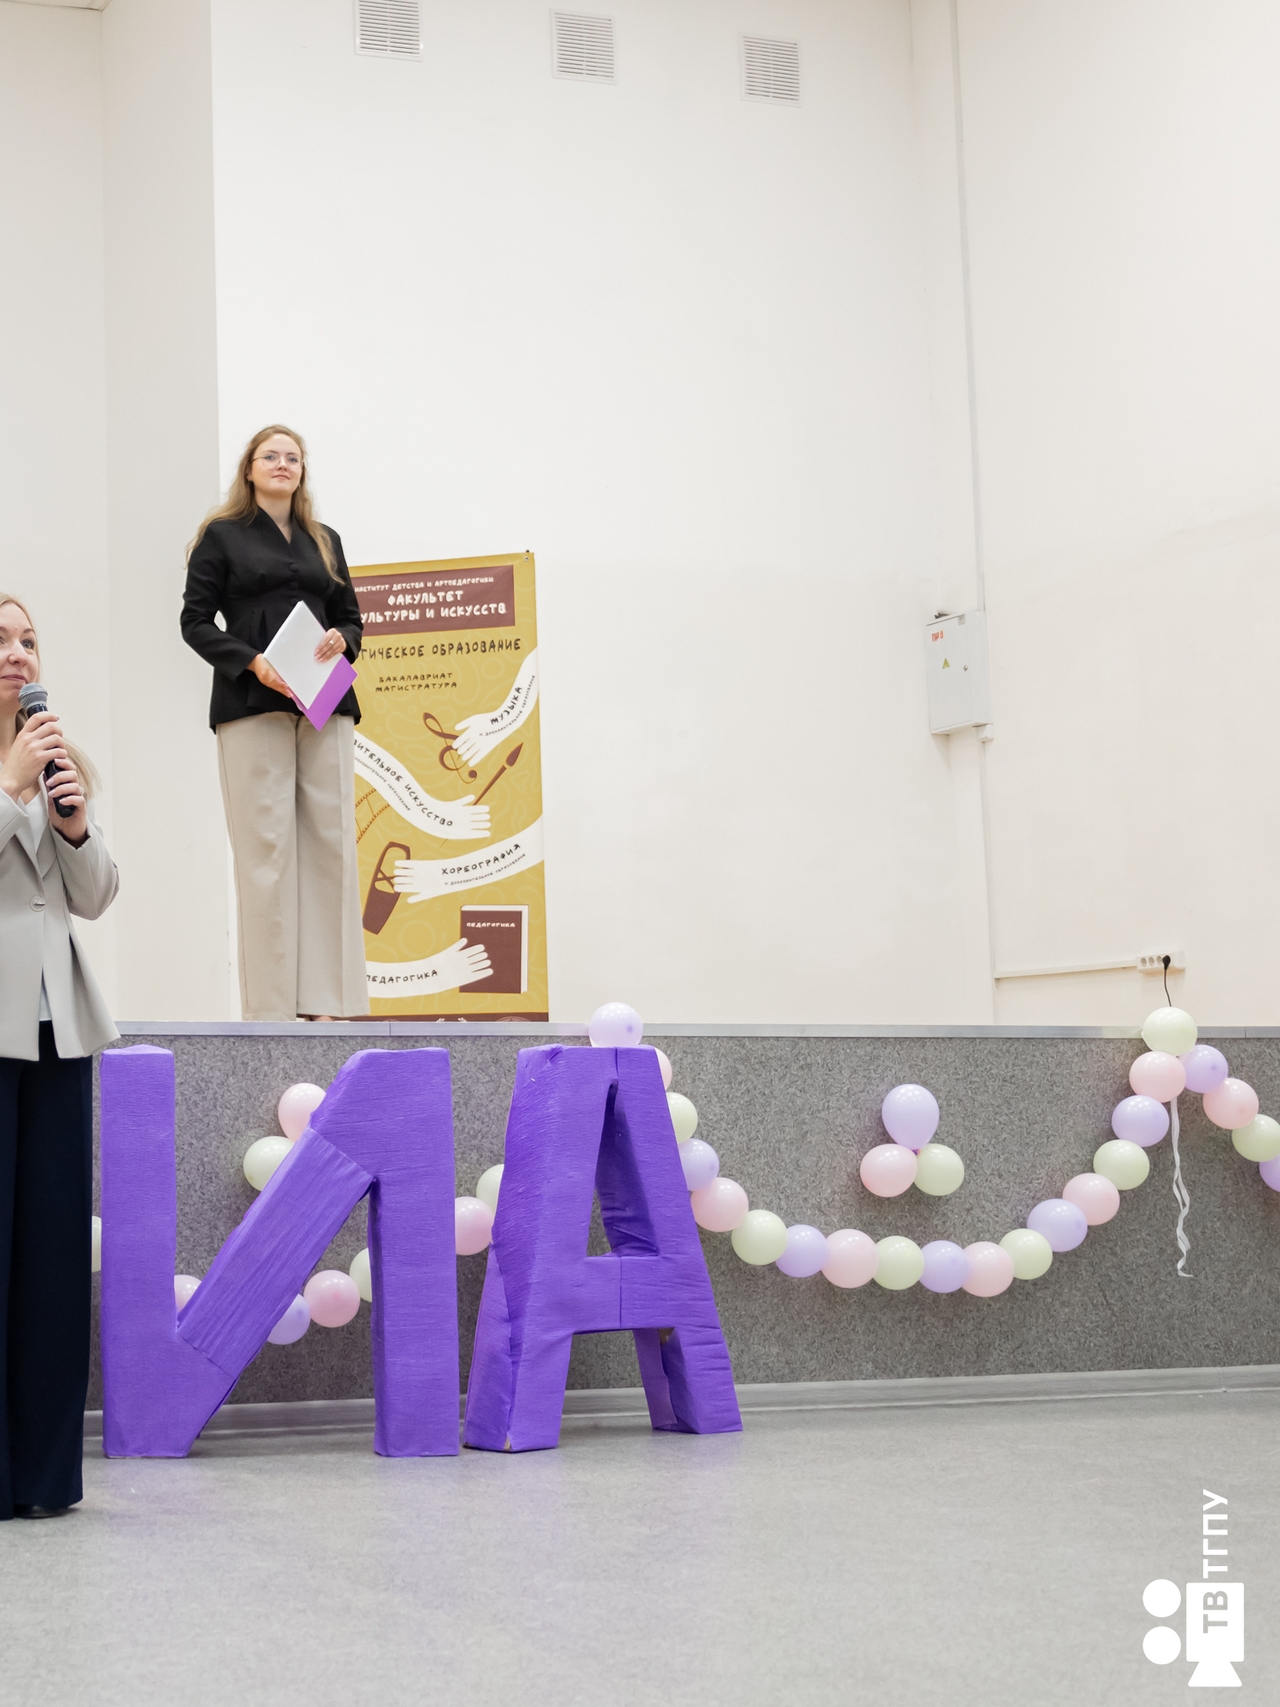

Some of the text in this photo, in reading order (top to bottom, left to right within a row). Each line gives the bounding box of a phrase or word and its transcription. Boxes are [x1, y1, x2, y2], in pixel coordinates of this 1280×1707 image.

[391, 582, 424, 591] ДЕТСТВА
[434, 577, 494, 587] АРТПЕДАГОГИКИ
[387, 590, 464, 606] ФАКУЛЬТЕТ
[361, 602, 508, 624] УЛЬТУРЫ И ИСКУССТВ
[360, 638, 521, 661] ГИЧЕСКОЕ ОБРАЗОВАНИЕ
[375, 681, 457, 692] МАГИСТРАТУРА
[379, 672, 453, 683] БАКАЛАВРИАТ
[490, 686, 522, 725] МУЗЫКА
[354, 739, 453, 827] ЗИТЕЛЬНОЕ ИСКУССТВО
[441, 843, 521, 876] ХОРЕОГРАФИЯ
